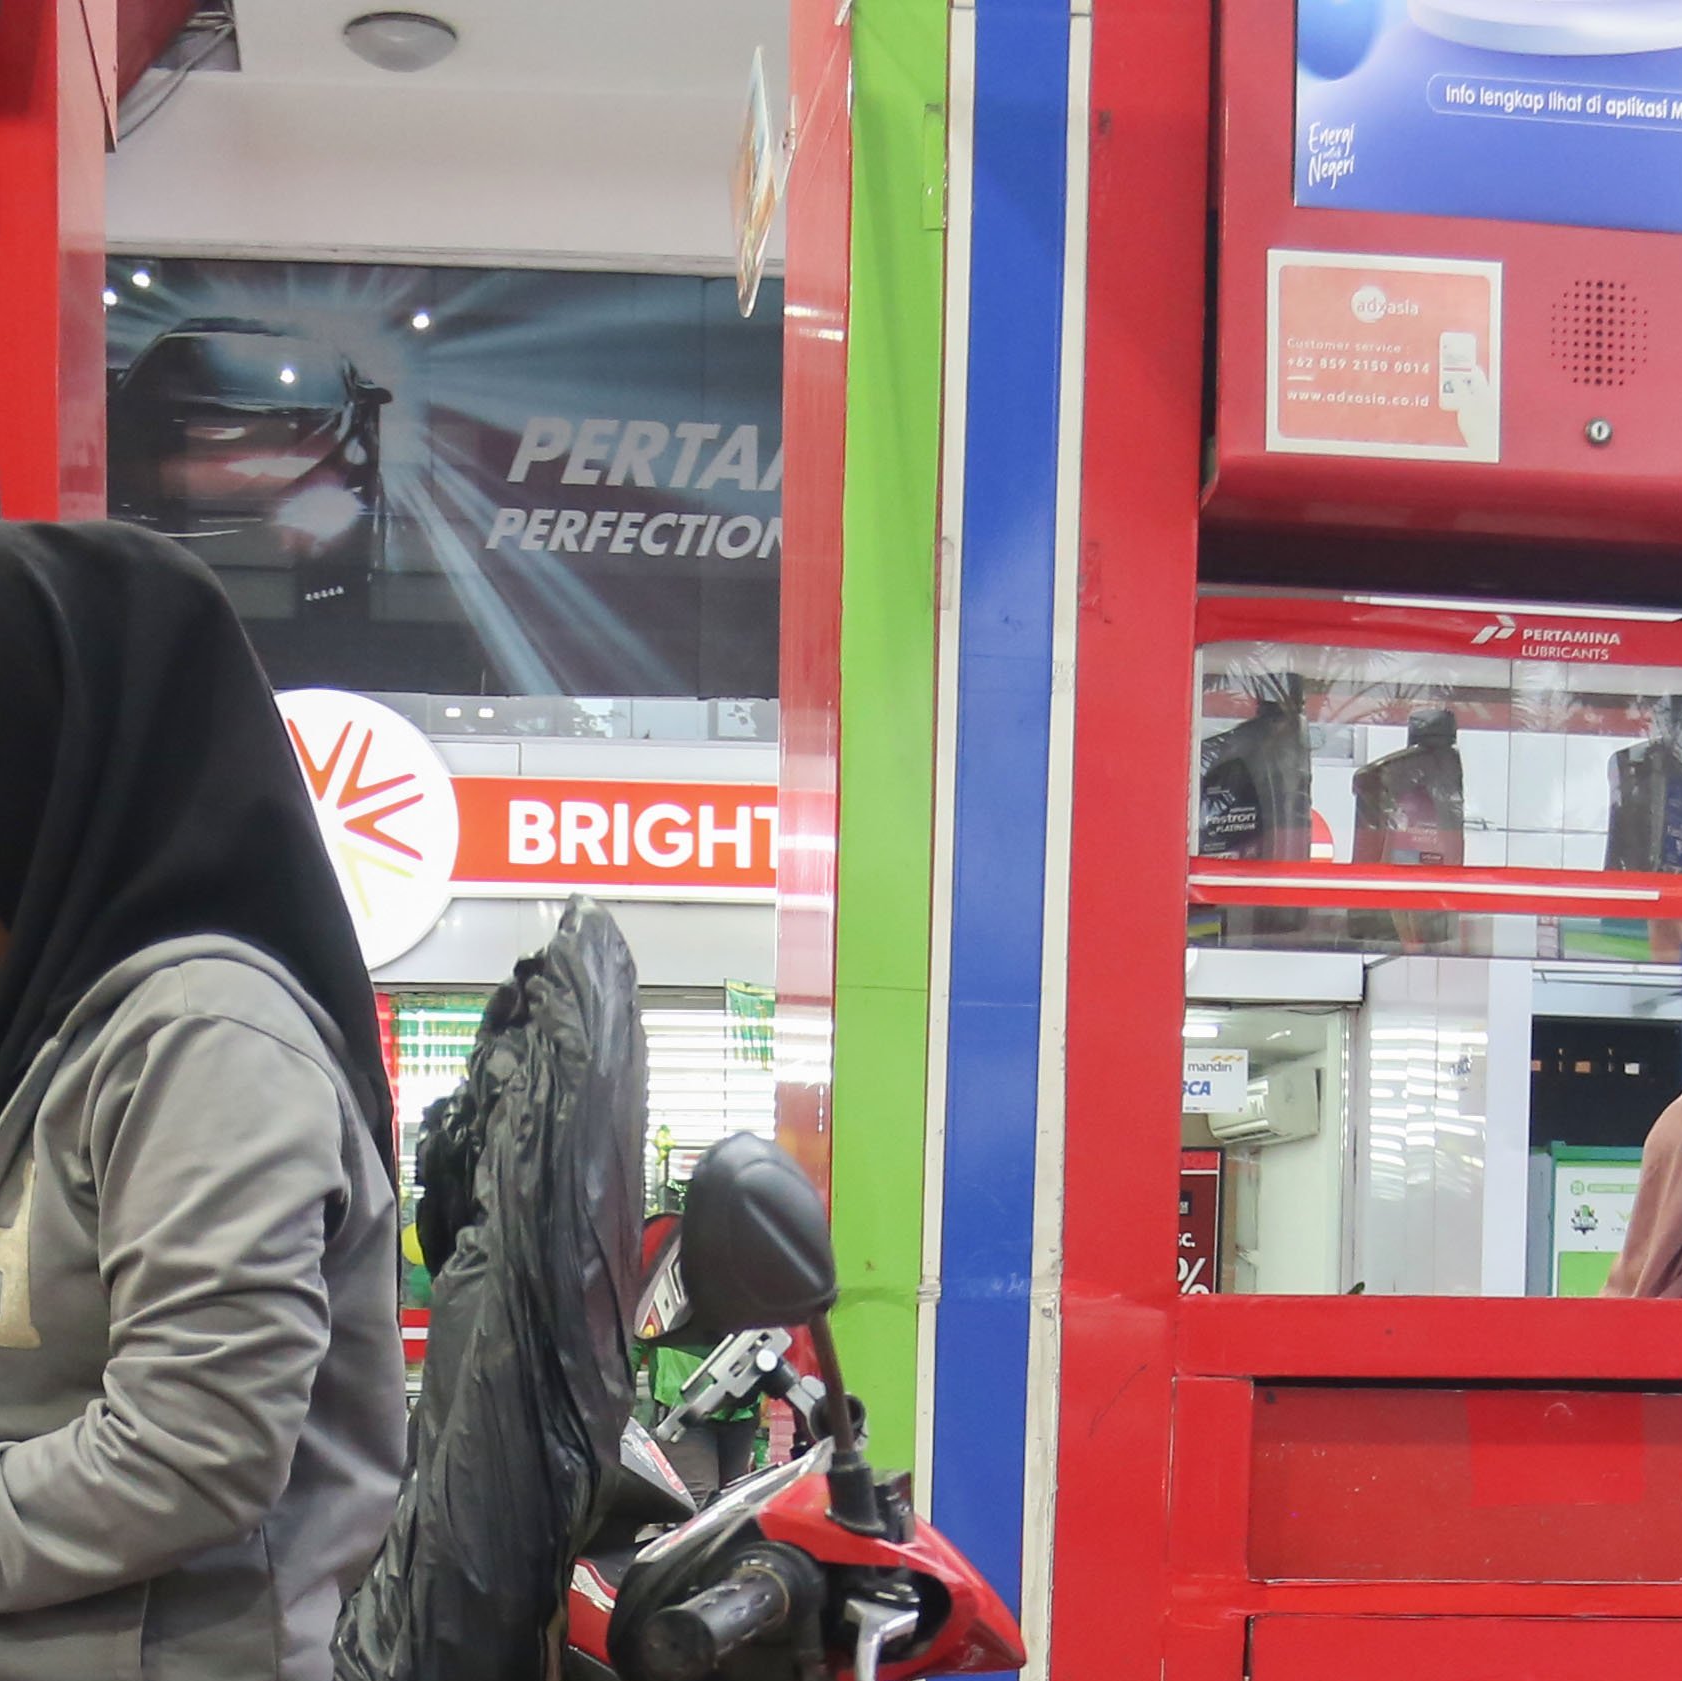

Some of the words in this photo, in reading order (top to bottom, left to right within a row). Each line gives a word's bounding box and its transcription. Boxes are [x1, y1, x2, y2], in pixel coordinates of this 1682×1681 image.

[1445, 86, 1476, 105] Info
[1479, 88, 1544, 114] lengkap
[1548, 91, 1583, 112] lihat
[1586, 94, 1602, 114] di
[1605, 97, 1667, 122] aplikasi
[1309, 122, 1354, 154] Energi
[1308, 154, 1354, 189] Negeri
[1287, 338, 1349, 351] Customer
[1355, 343, 1401, 353] service
[1287, 357, 1313, 368] +62
[1319, 358, 1347, 370] 859
[1287, 390, 1429, 407] www.adxasia.co.id
[506, 416, 783, 491] PERTA
[1523, 627, 1621, 646] PERTAMINA
[1521, 644, 1609, 661] LUBRICANTS
[508, 800, 778, 869] BRIGHT
